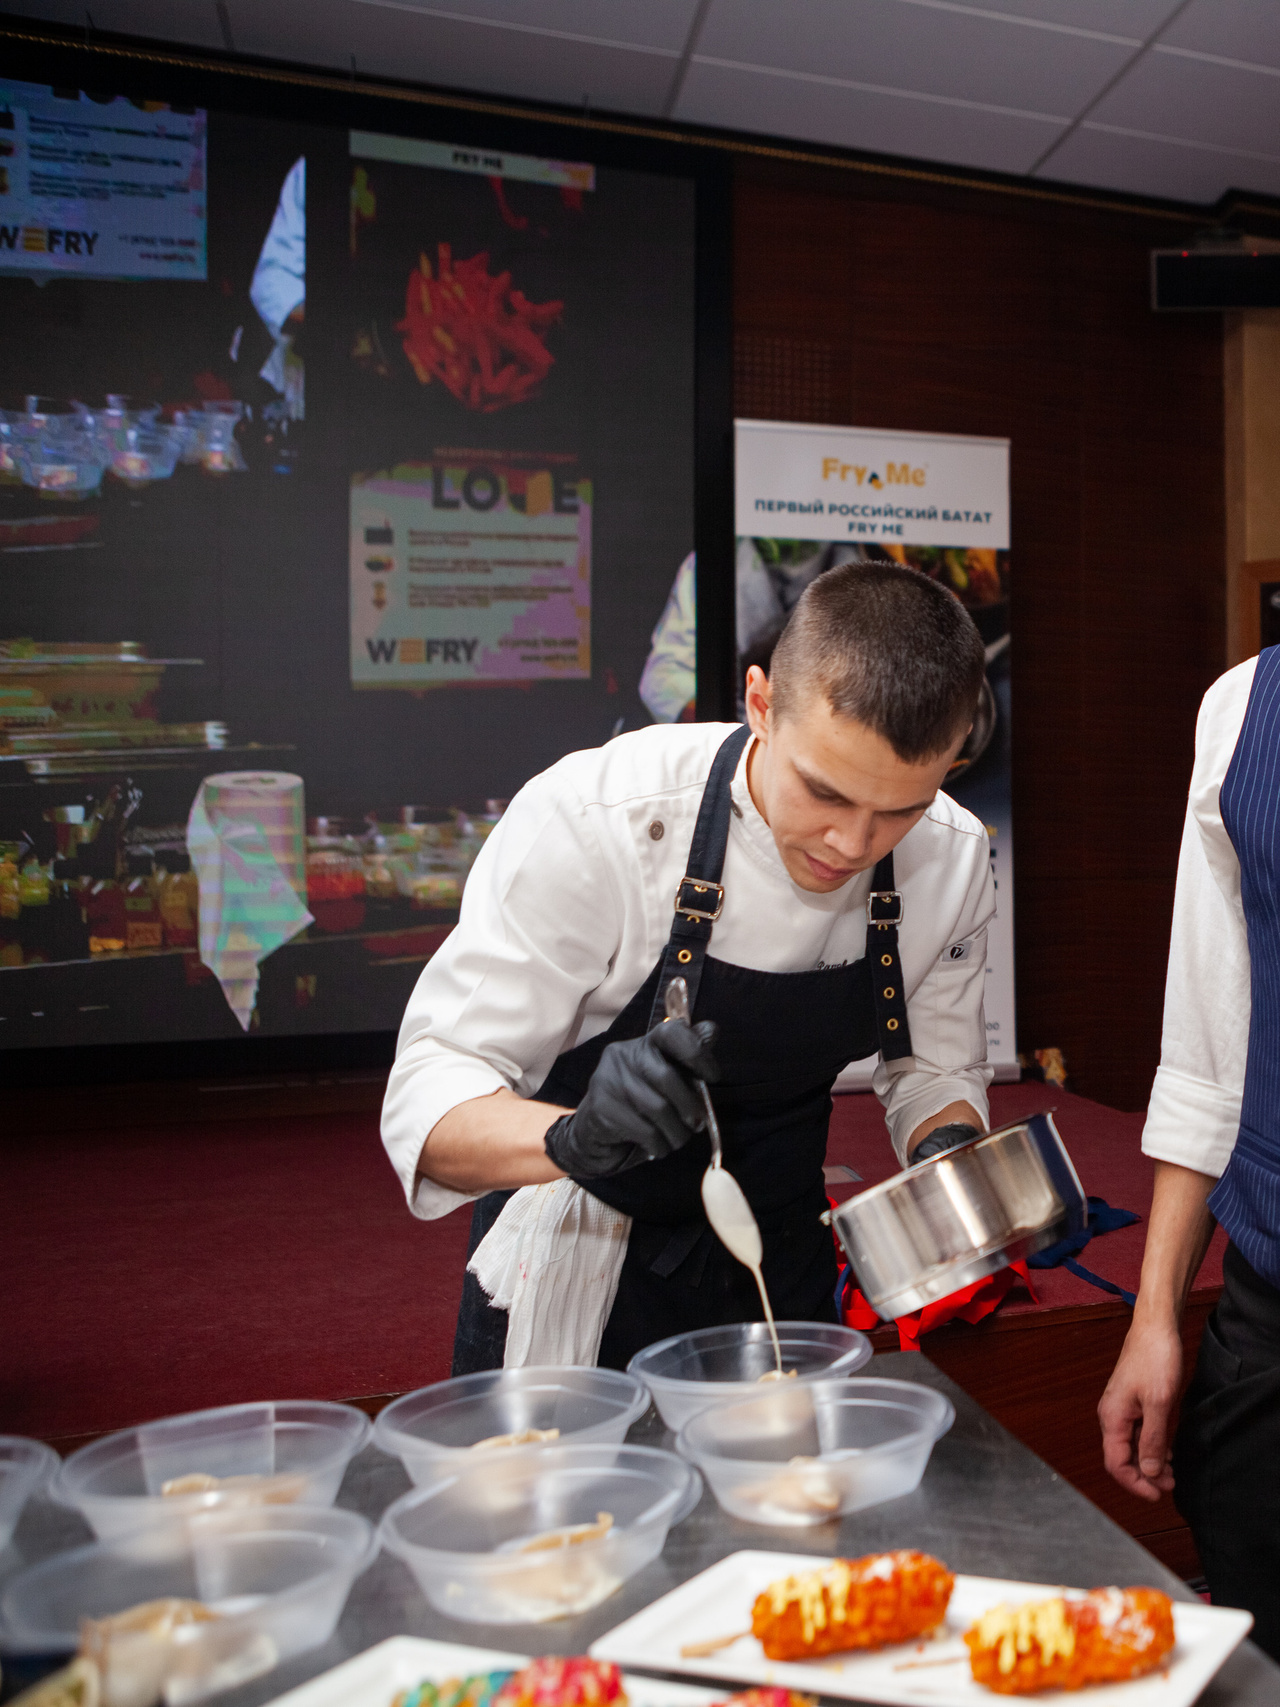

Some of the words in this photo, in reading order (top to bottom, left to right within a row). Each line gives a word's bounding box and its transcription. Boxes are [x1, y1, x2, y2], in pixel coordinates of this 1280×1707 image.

[821, 457, 867, 487] Fry
[886, 462, 926, 487] Me
[754, 498, 824, 515] ПЕРВЫЙ
[828, 501, 938, 520] РОССИЙСКИЙ
[942, 508, 993, 524] БАТАТ
[848, 522, 877, 535] FRY
[882, 523, 904, 536] ME
